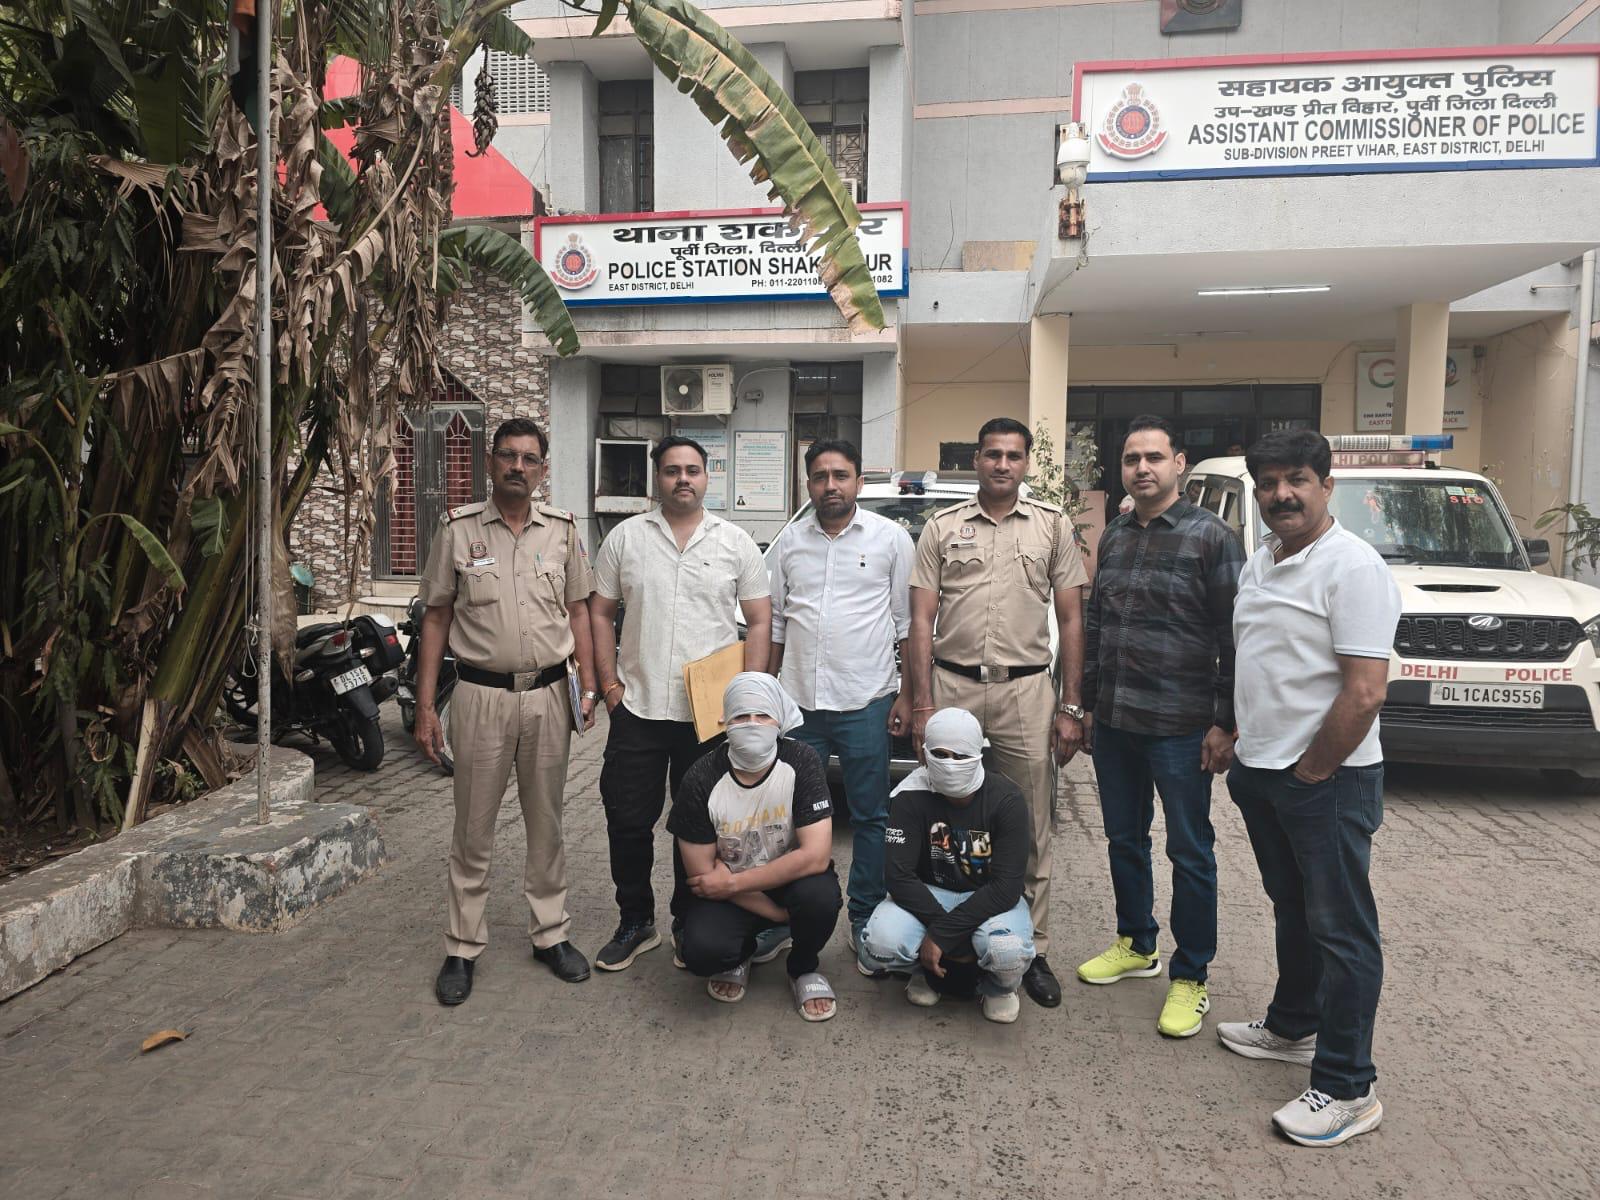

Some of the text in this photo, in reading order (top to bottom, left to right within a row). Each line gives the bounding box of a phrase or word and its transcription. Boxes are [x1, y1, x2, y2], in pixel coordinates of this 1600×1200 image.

[1218, 64, 1556, 99] सहायक आयुक्त पुलिस
[1302, 99, 1338, 118] प्रीत
[1445, 94, 1497, 111] जिला
[1501, 92, 1558, 110] दिल्ली
[1188, 112, 1585, 145] ASSISTANT COMMISSIONER OF POLICE
[1223, 138, 1545, 161] SUB-DIVISION PREET VIHAR, EAST DISTRICT, DELHI
[612, 224, 708, 244] थाना
[670, 243, 700, 261] पूर्वी
[759, 240, 808, 254] दिल्ली
[608, 254, 892, 280] POLICE STATION SHAKUR
[608, 283, 629, 291] EAST
[631, 282, 669, 291] DISTRICT,
[670, 281, 694, 290] DELHI
[751, 279, 768, 288] PH:
[1401, 664, 1572, 682] DELHI POLICE
[1441, 686, 1543, 705] DL1CAC9556
